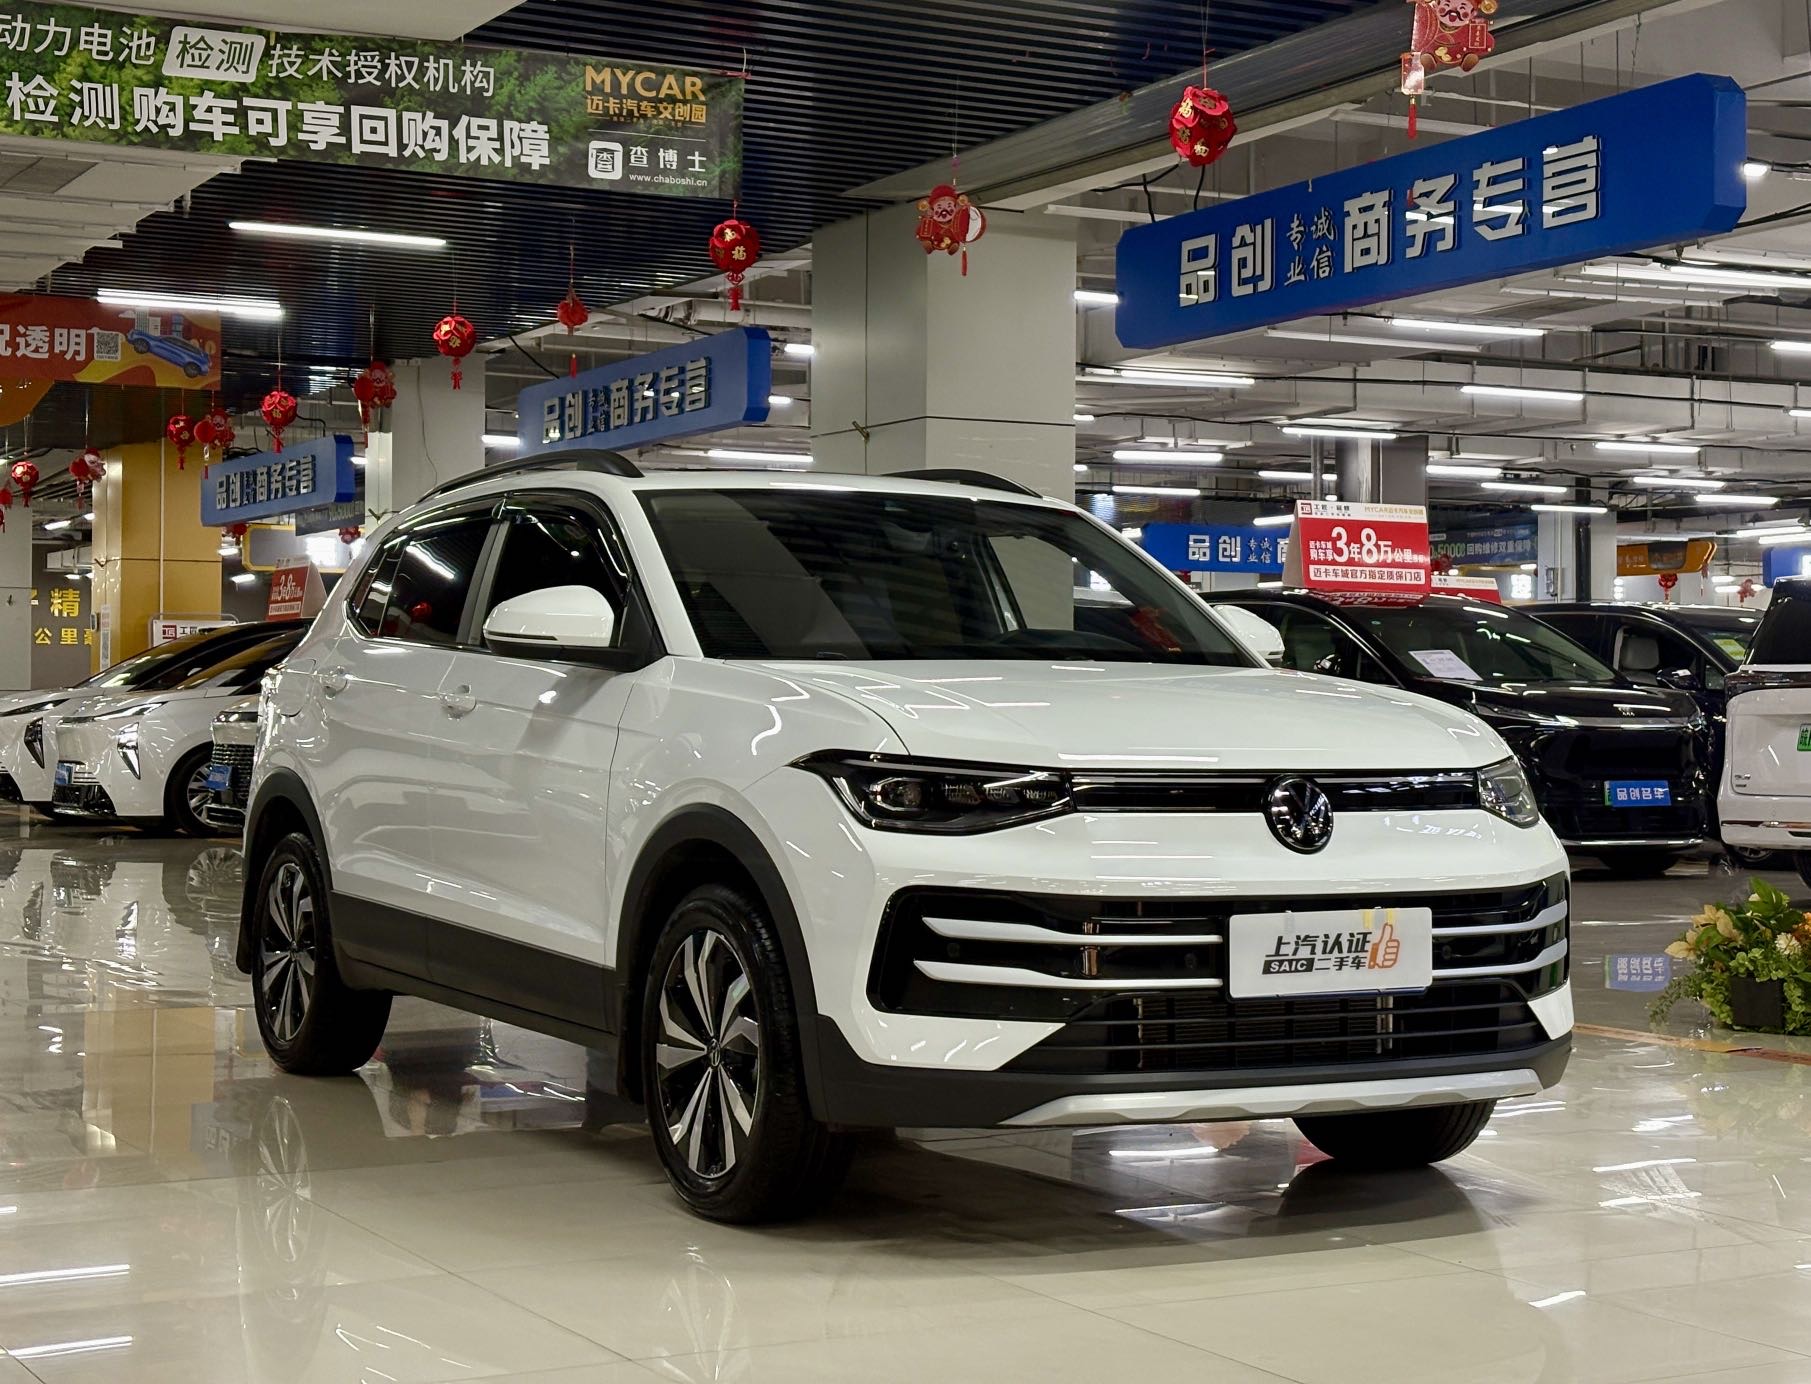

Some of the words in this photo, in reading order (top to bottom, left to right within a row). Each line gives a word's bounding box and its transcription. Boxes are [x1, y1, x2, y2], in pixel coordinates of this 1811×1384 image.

[0, 13, 156, 65] 动力电池
[175, 33, 255, 75] 检测
[267, 43, 495, 97] 技术授权机构
[585, 65, 706, 101] MYCAR
[586, 95, 707, 123] 迈卡汽车文创园
[628, 145, 707, 172] 查博士
[628, 172, 708, 187] www.chaboshi.cn
[1179, 217, 1275, 308] 品创
[1343, 134, 1602, 274] 商务专营
[1188, 534, 1241, 562] 品创
[1313, 567, 1422, 582] 迈卡车城官方指定质保门店
[1616, 787, 1665, 800] 品创名车
[1265, 931, 1372, 958] 上汽认证
[1269, 959, 1307, 973] SAIC
[1314, 955, 1368, 971] 二手车
